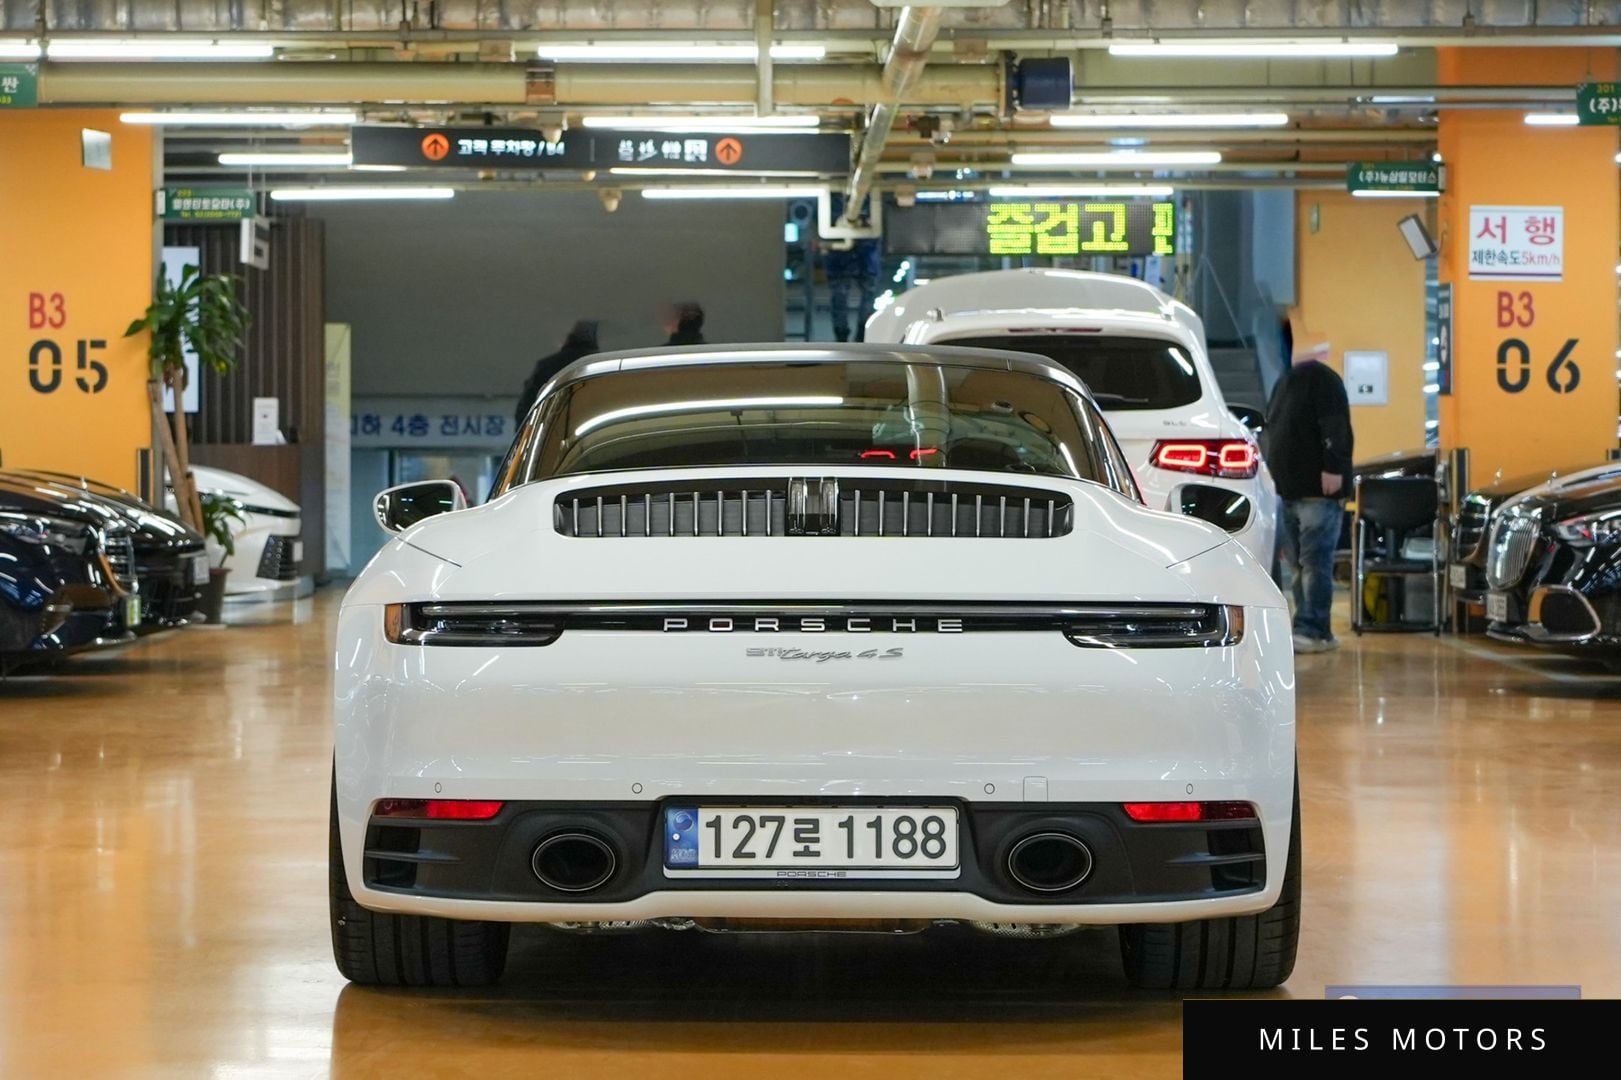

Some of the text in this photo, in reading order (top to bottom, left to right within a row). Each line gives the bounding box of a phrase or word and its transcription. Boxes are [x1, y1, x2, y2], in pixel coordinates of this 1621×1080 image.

[986, 202, 1129, 255] 즐겁고
[29, 292, 66, 330] B3
[1496, 291, 1535, 328] B3
[663, 617, 963, 632] PORSCHE
[705, 814, 947, 860] 127로 1188
[776, 870, 848, 878] PORSCHE
